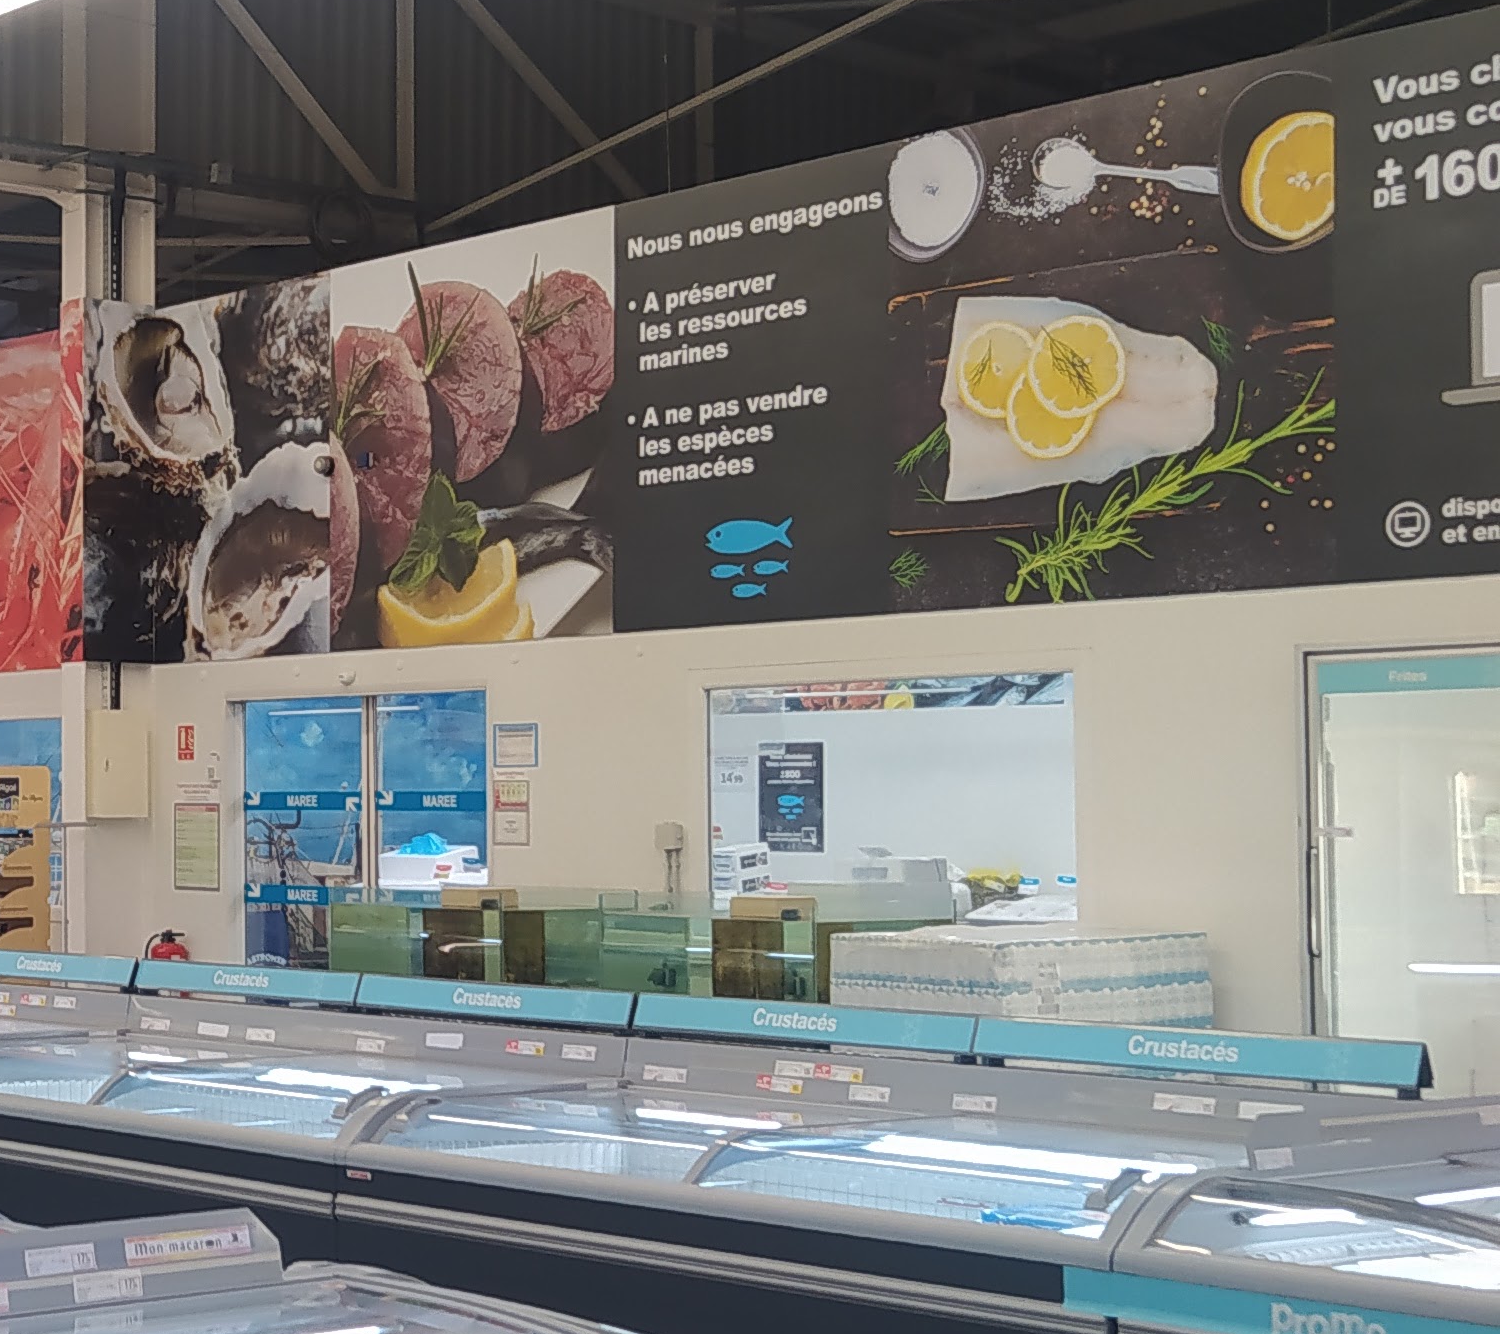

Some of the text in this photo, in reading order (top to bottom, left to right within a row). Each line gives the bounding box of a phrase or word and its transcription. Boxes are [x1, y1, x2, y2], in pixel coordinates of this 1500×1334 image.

[1372, 69, 1461, 104] Vous
[1373, 110, 1457, 143] vous
[1373, 184, 1407, 208] DE
[627, 191, 883, 260] Nous nous engageons
[642, 273, 776, 314] A préserver
[639, 298, 807, 343] les ressources
[640, 341, 729, 371] marines
[642, 384, 828, 428] A ne pas vendre
[639, 424, 774, 457] les espèces
[638, 455, 755, 486] menacées
[1441, 524, 1468, 544] et
[286, 794, 319, 808] MAREE
[422, 794, 458, 808] MAREE
[286, 889, 319, 903] MAREE
[17, 956, 62, 973] Crustacés
[213, 970, 269, 988] Crustacés
[453, 987, 522, 1009] Crustacés
[752, 1007, 838, 1033] Crustacés
[1128, 1034, 1240, 1064] Crustacés
